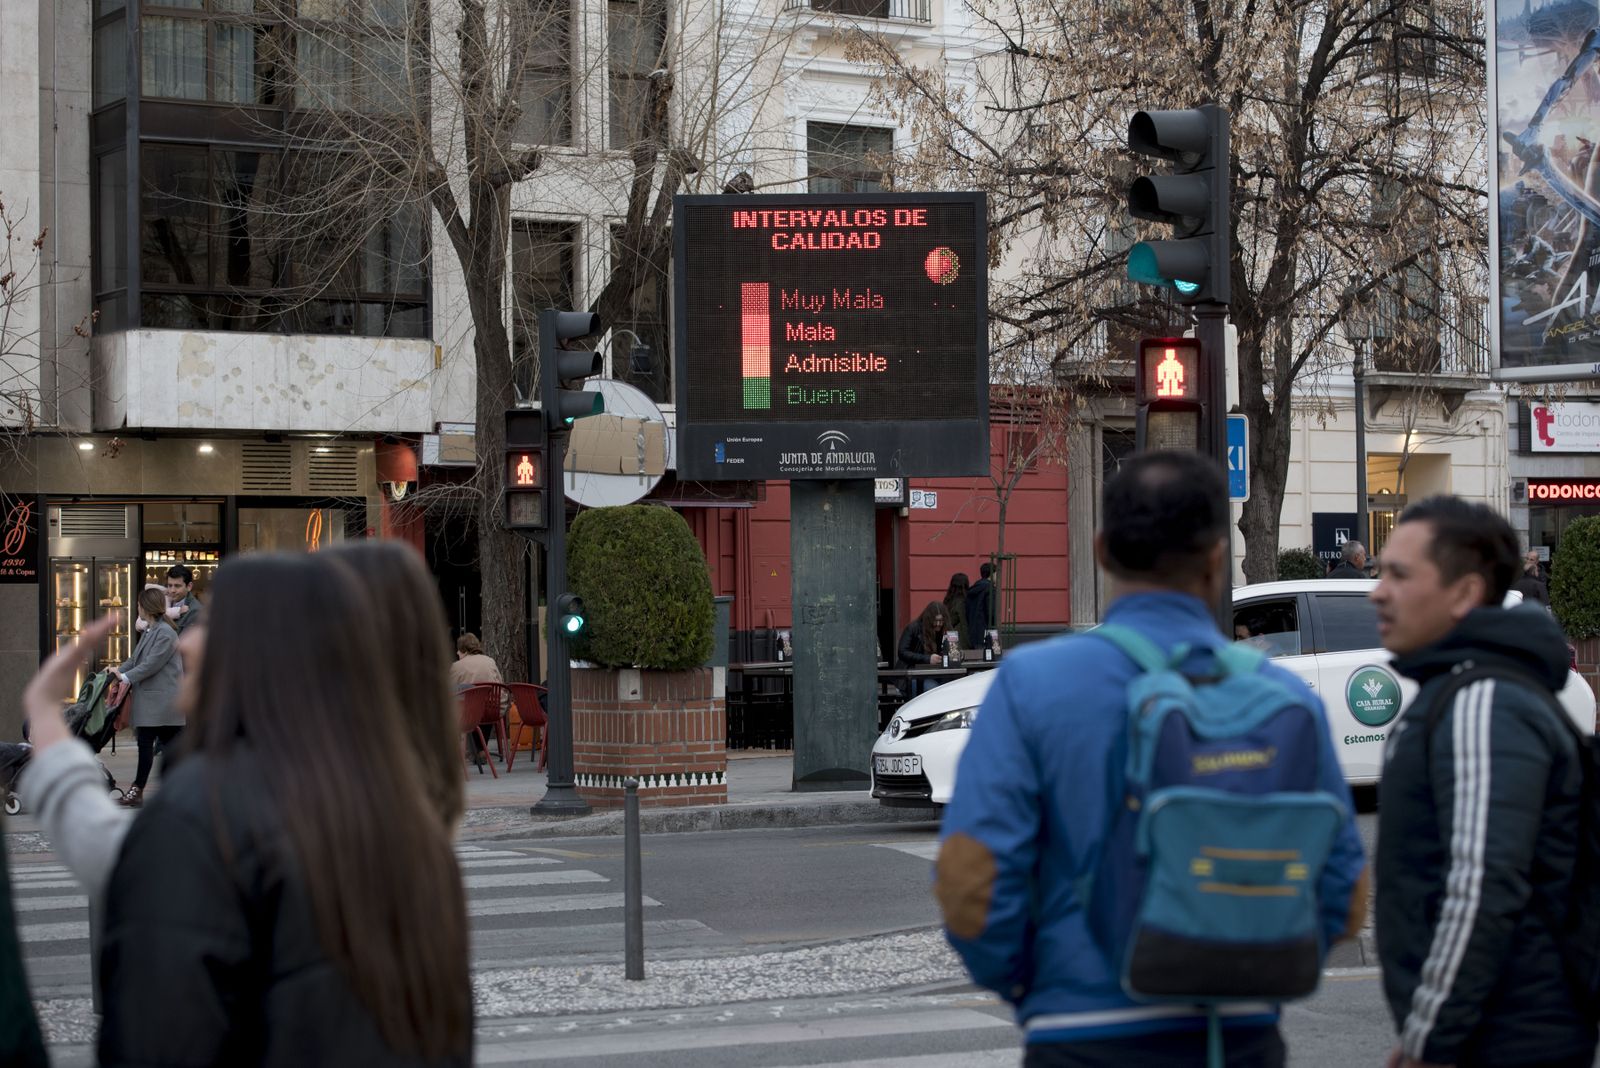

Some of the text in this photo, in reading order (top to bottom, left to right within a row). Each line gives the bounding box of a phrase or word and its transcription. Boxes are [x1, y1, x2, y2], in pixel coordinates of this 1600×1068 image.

[733, 209, 927, 228] INTERVALOS DE
[771, 232, 881, 250] CALIDAD
[781, 288, 885, 314] Muy Mala
[786, 322, 835, 341] Mala
[784, 353, 887, 373] Admisible
[787, 386, 856, 404] Buena
[779, 452, 808, 465] JUNTA
[811, 452, 823, 465] DE
[847, 464, 878, 472] Ambiente
[2, 559, 26, 567] 1930
[16, 568, 36, 577] Copas
[1356, 698, 1394, 708] CAJA RURAL
[1344, 733, 1386, 745] Estamos
